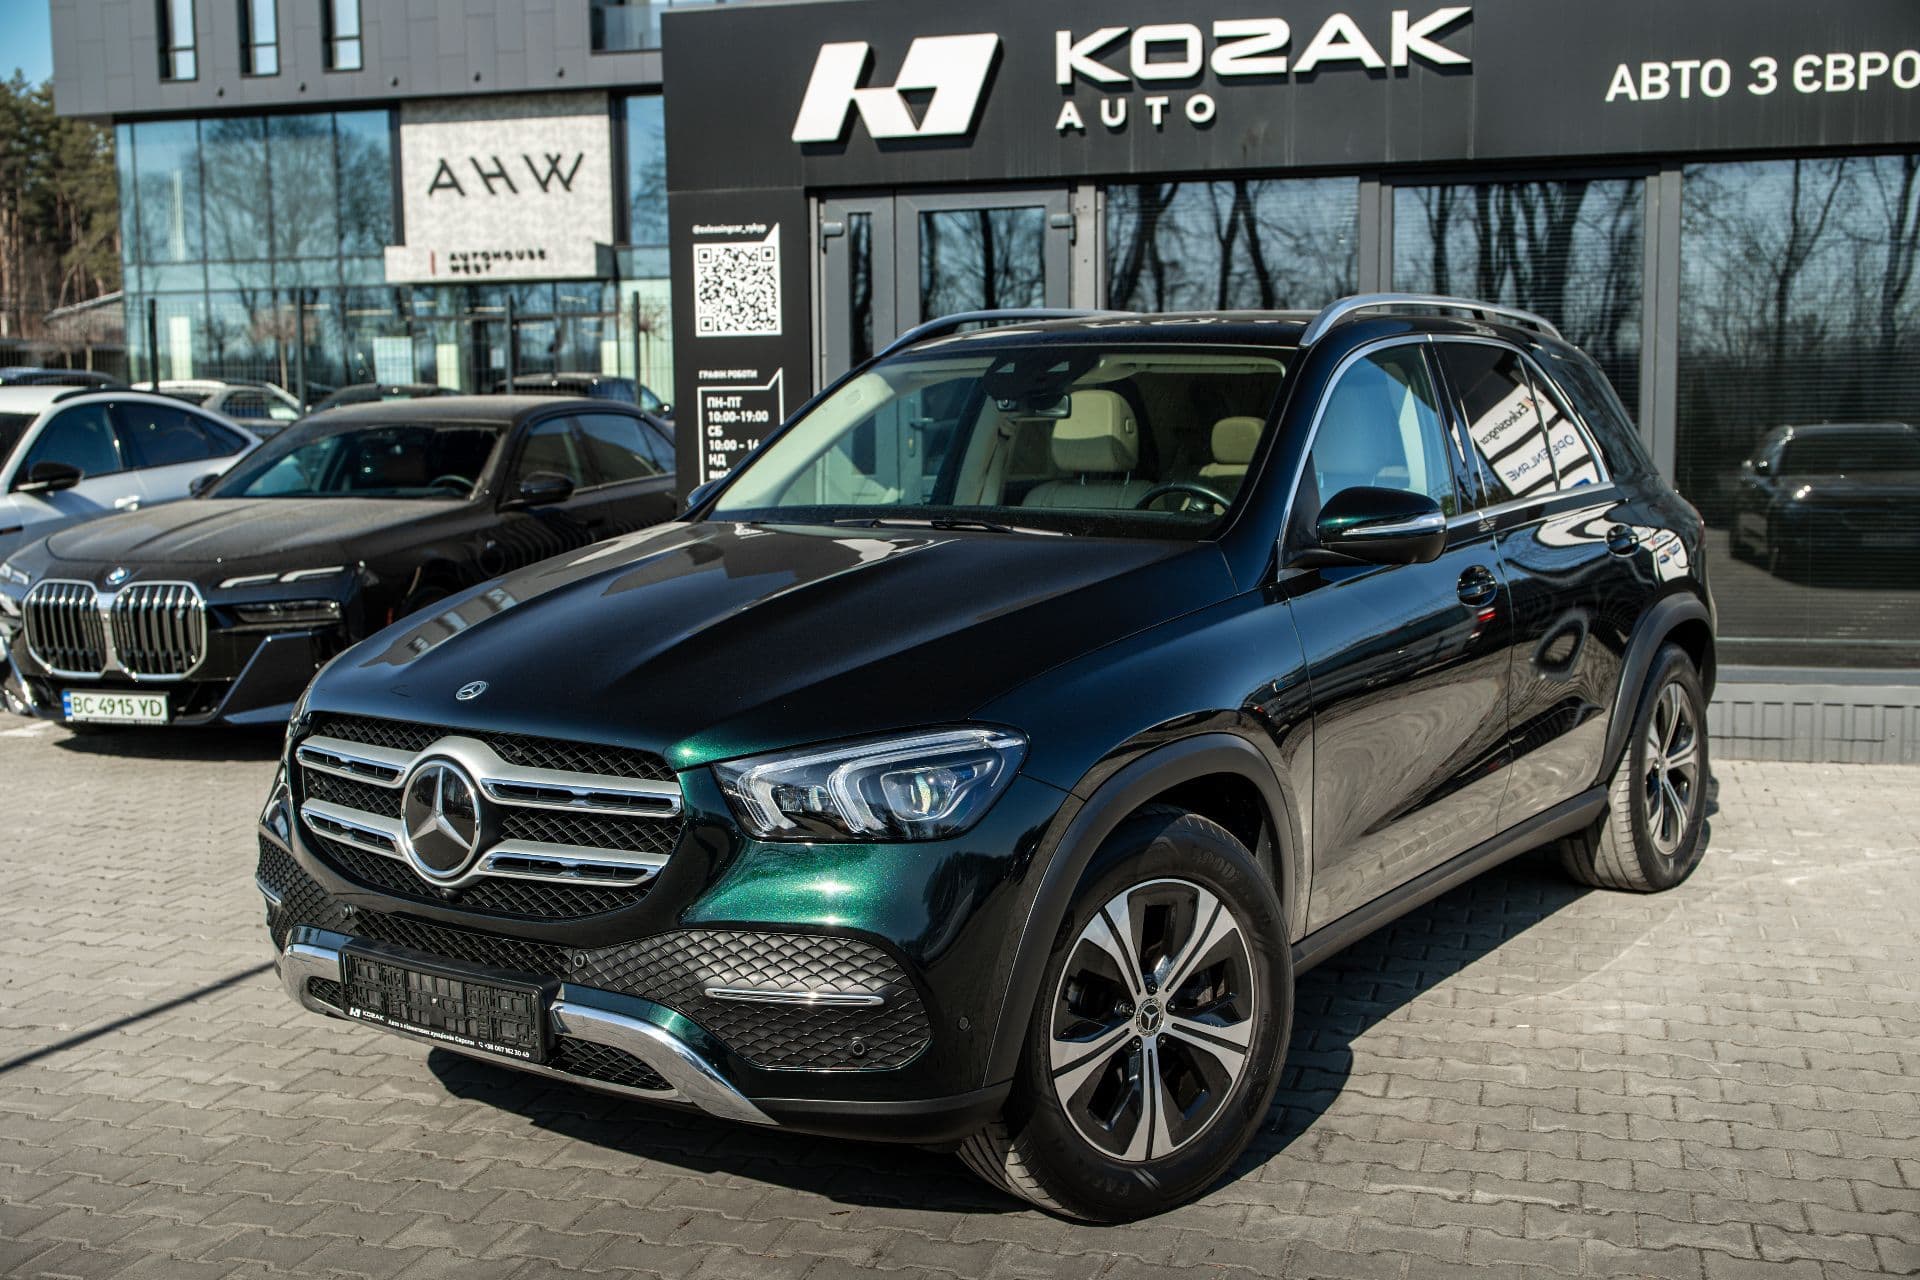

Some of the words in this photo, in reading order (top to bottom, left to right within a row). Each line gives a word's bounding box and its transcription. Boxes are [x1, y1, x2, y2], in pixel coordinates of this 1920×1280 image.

[1055, 6, 1473, 86] KOZAK
[1604, 58, 1732, 102] АВТО
[1747, 56, 1778, 95] З
[1793, 49, 1920, 93] ЄВРО
[1055, 93, 1217, 130] AUTO
[427, 152, 584, 197] AHW
[449, 249, 547, 263] AUTOHOUSE
[450, 262, 492, 275] WEST
[706, 396, 743, 409] ПН-ПТ
[707, 410, 770, 423] 10:00-19:00
[707, 425, 724, 438] СБ
[708, 439, 738, 452] 10:00
[708, 453, 727, 468] НД
[73, 697, 95, 714] BC
[99, 698, 135, 716] 4915
[138, 699, 163, 717] YD
